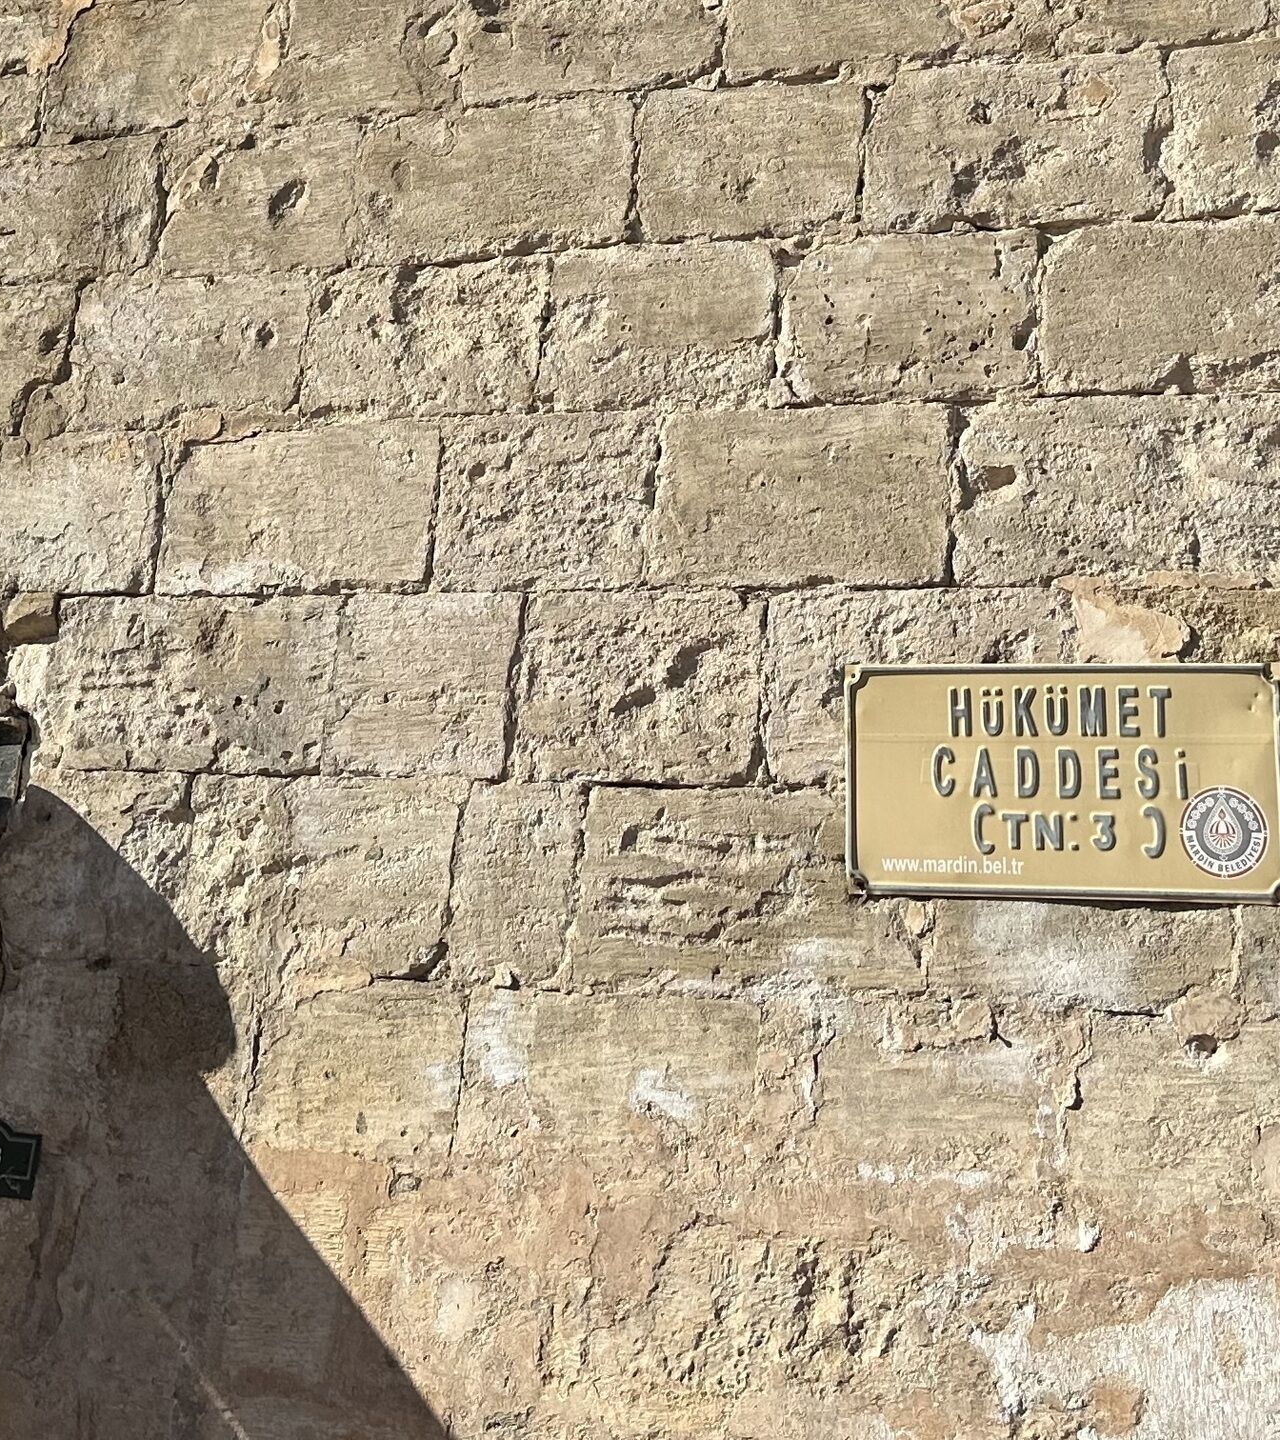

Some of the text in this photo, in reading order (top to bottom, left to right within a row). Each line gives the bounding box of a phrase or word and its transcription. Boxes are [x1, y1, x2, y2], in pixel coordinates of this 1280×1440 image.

[948, 684, 1173, 738] HÜKÜMET
[929, 744, 1189, 800] CADDESİ
[881, 855, 1025, 875] www.mardin.bel.tr
